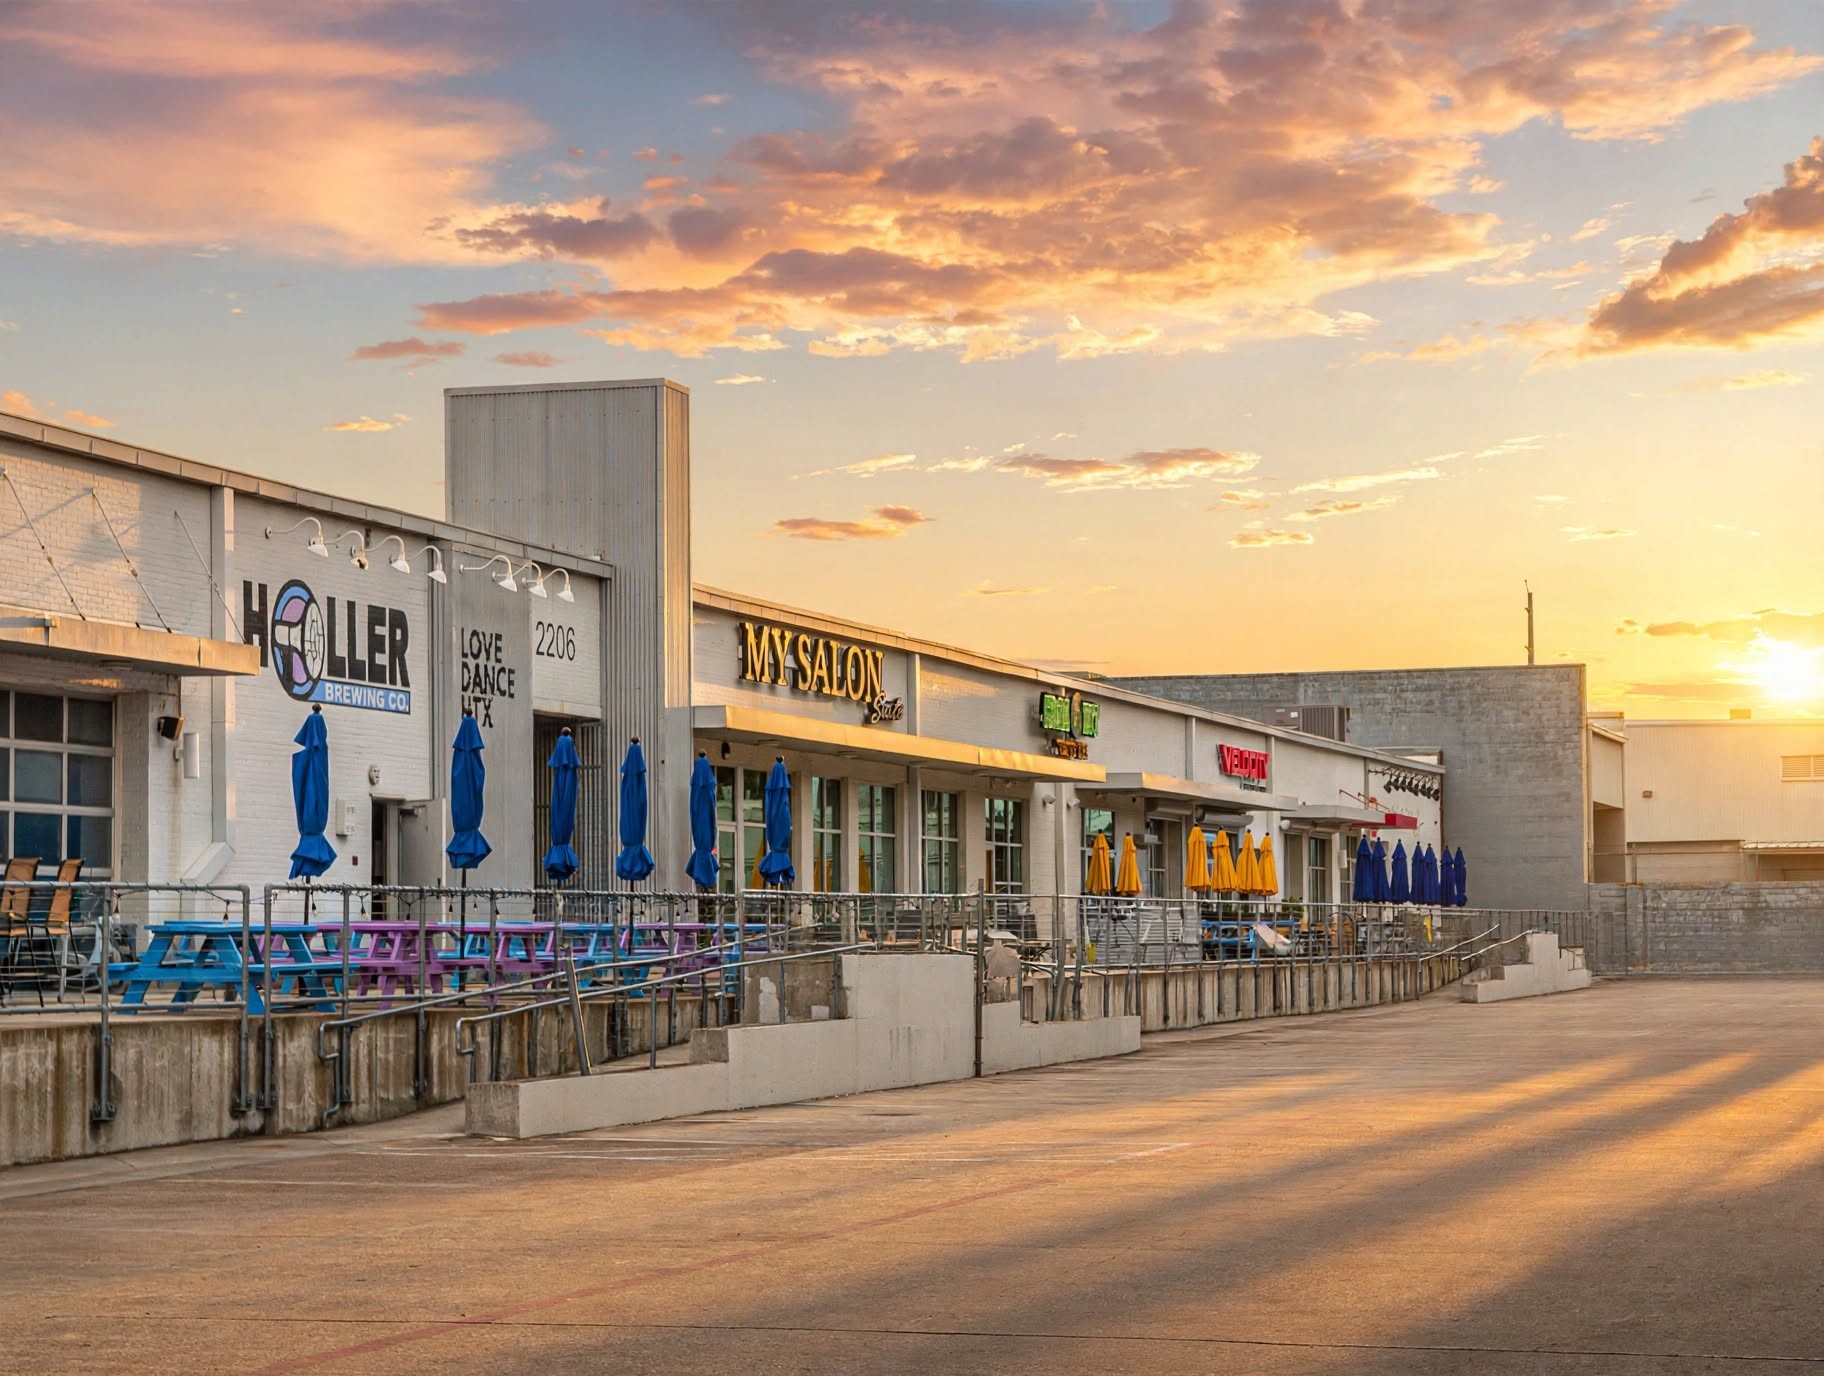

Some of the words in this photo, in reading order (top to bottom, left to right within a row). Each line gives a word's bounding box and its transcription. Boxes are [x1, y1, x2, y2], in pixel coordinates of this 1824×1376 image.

[461, 626, 503, 664] LOVE
[535, 620, 576, 661] 2206
[461, 661, 516, 699] DANCE
[740, 622, 792, 686] MY
[794, 633, 885, 703] SALON
[324, 682, 385, 707] BREWING
[388, 692, 409, 711] CO.
